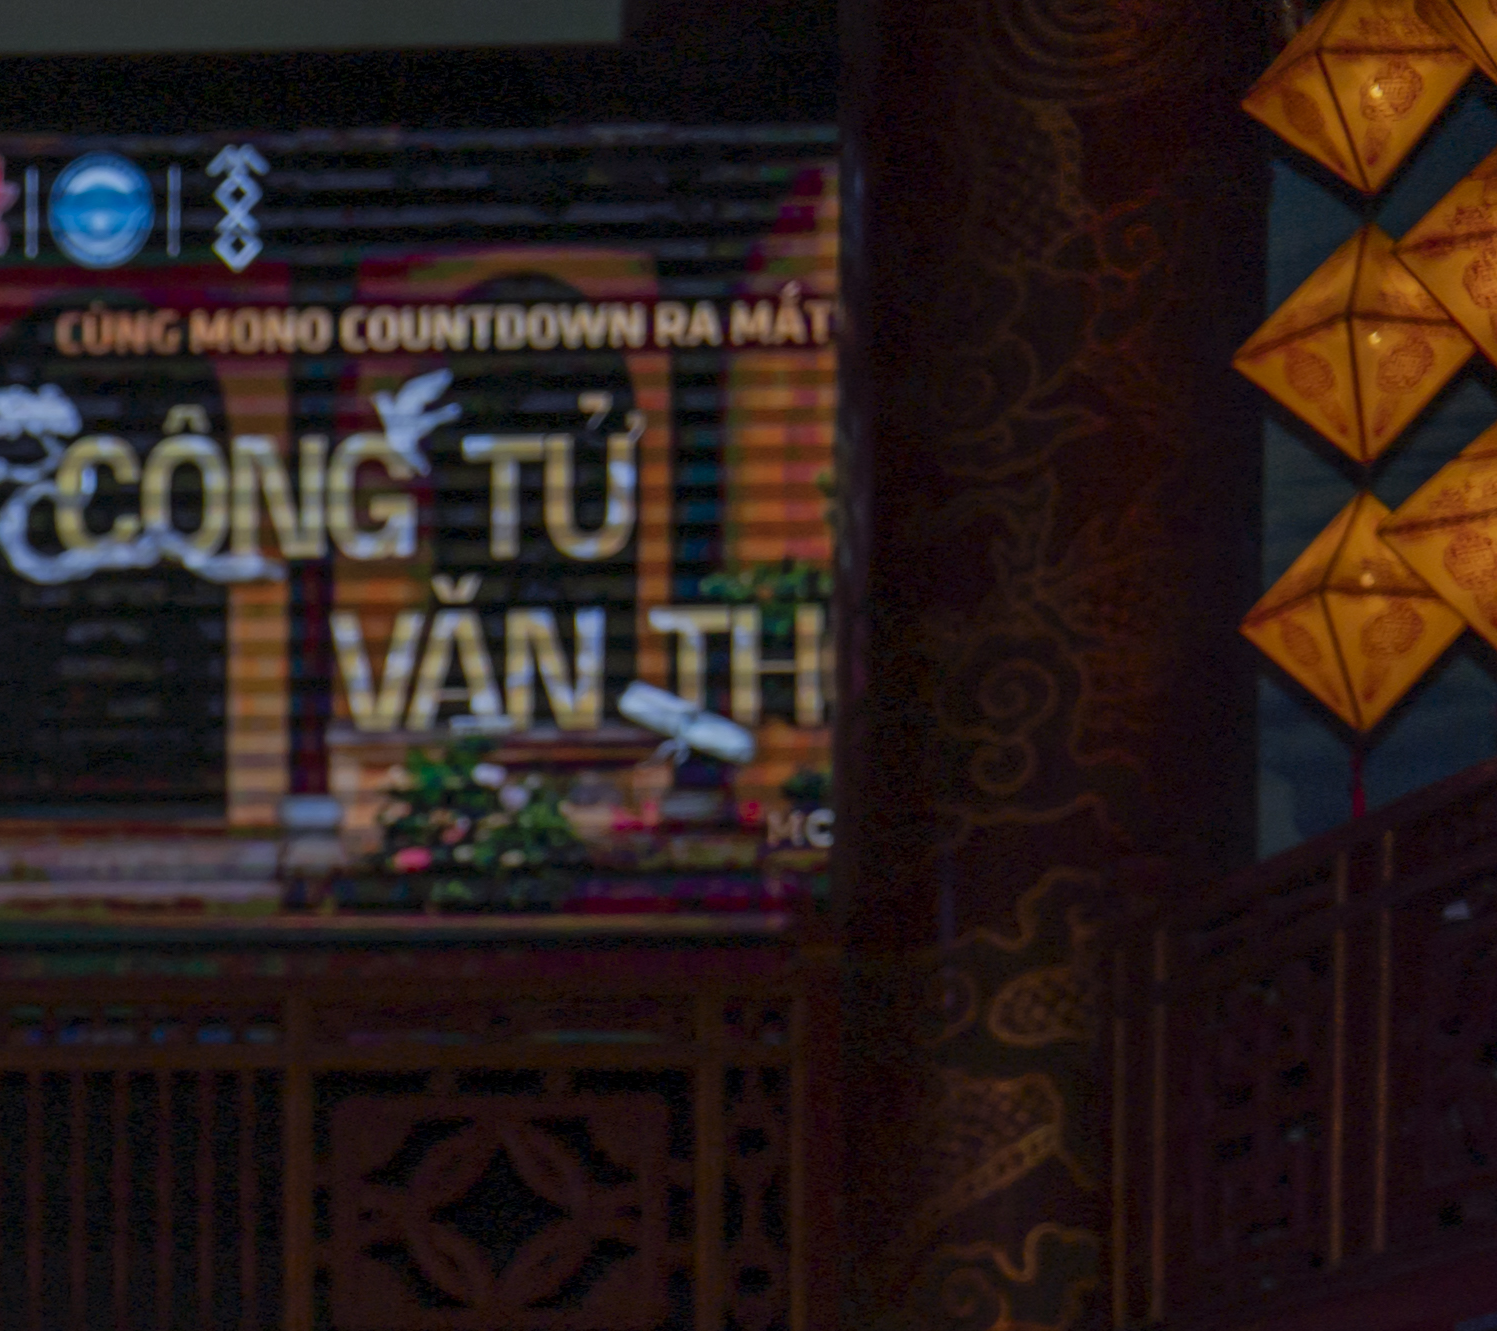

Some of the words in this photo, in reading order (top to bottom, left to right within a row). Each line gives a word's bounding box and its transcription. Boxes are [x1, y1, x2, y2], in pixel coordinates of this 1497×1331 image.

[188, 305, 332, 353] MONO
[337, 302, 646, 351] COUNTDOWN
[654, 299, 724, 348] RA
[53, 403, 416, 562] CÔNG
[461, 393, 646, 563] TỬ
[328, 572, 606, 733] VĂN
[648, 603, 838, 727] TH
